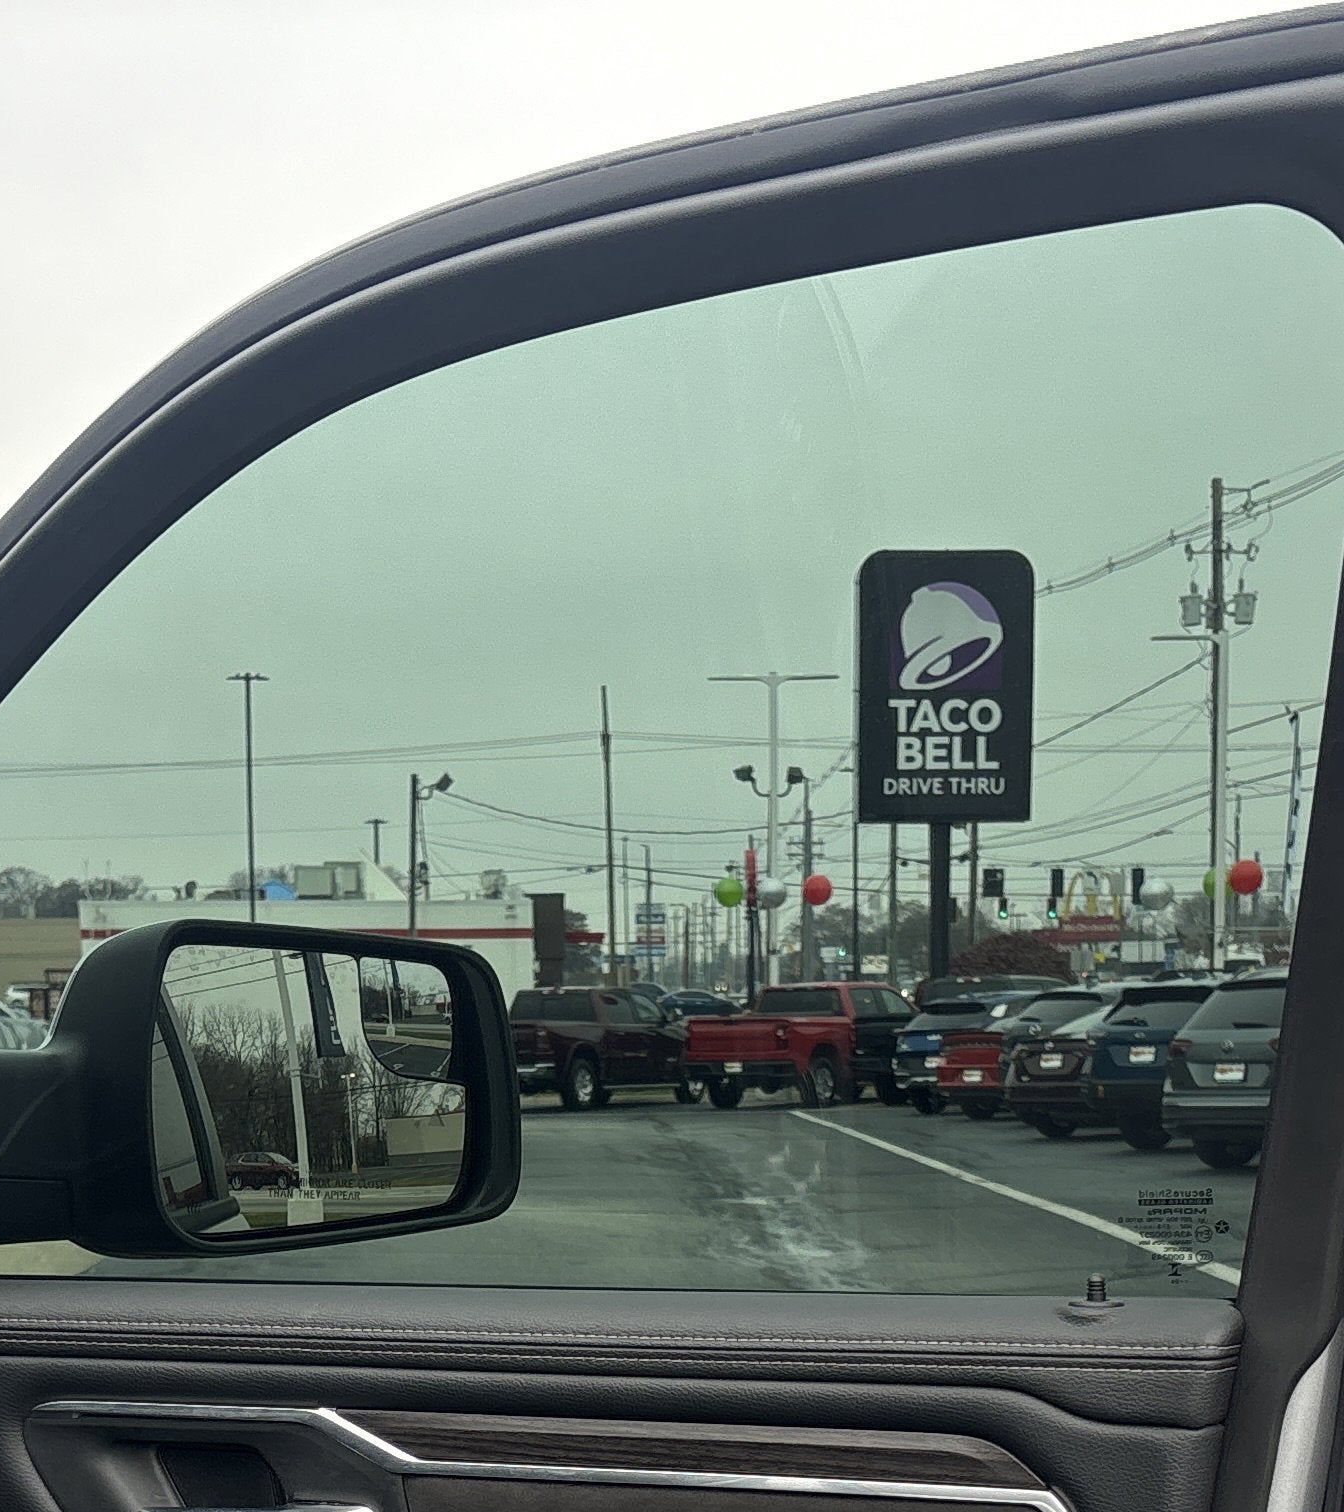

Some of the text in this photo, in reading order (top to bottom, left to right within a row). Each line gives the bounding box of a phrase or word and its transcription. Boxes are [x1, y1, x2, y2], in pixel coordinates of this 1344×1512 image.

[887, 698, 1003, 733] TACO
[896, 735, 1000, 771] BELL
[883, 777, 1006, 795] DRIVE THRU
[268, 1188, 361, 1201] THAN THEY APPEAR
